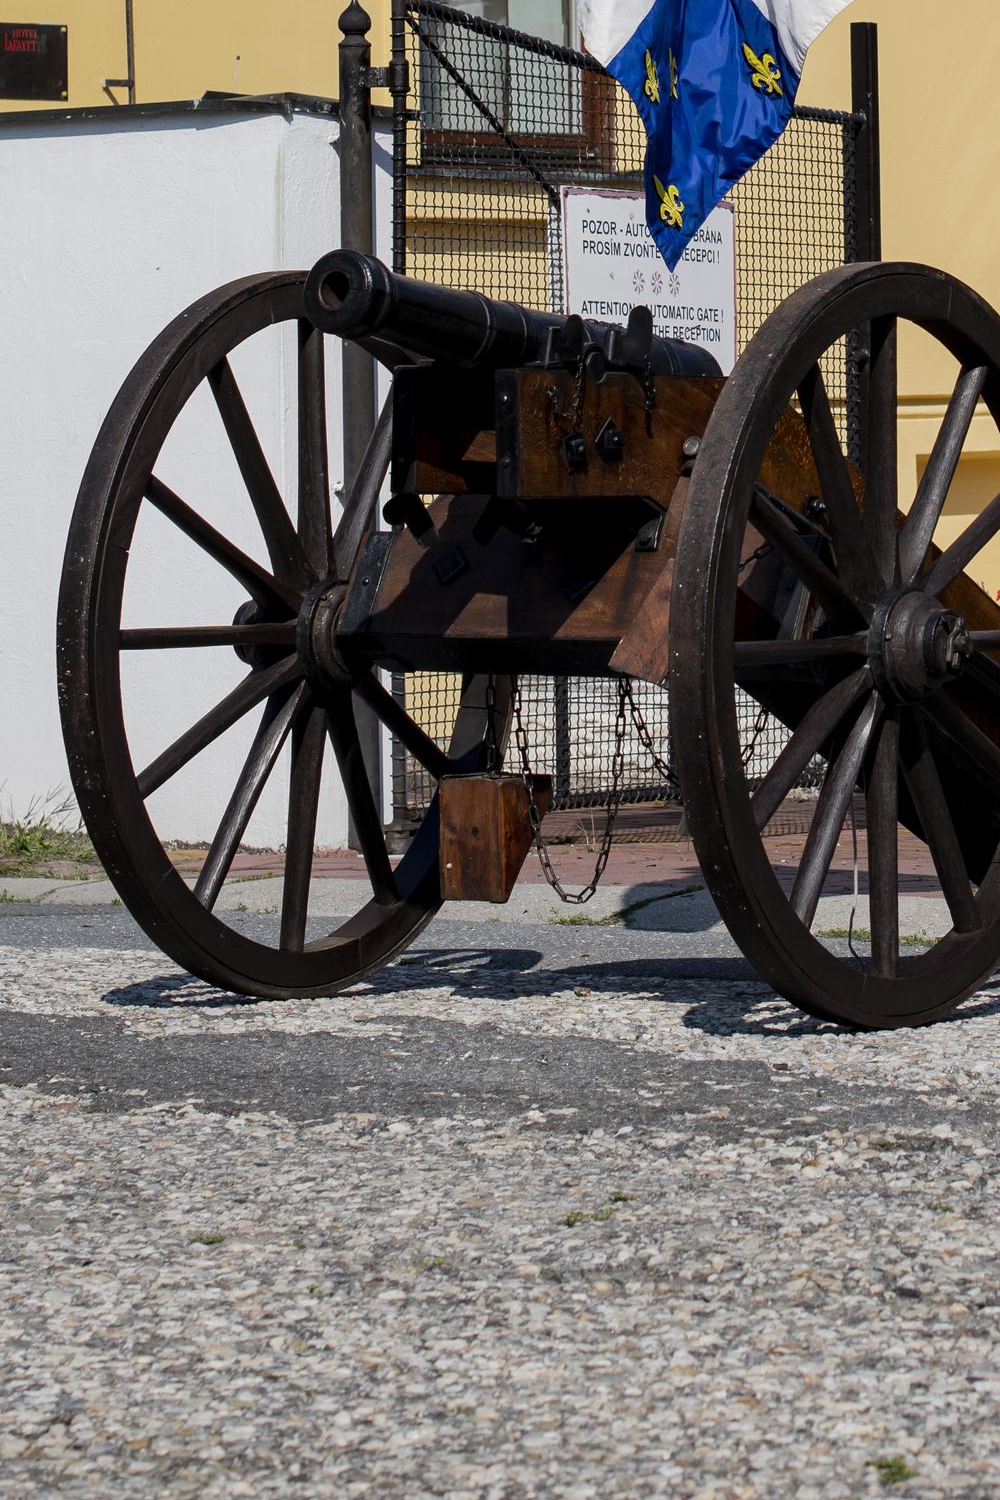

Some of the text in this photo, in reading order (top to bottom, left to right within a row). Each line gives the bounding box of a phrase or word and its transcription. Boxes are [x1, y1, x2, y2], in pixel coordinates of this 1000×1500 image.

[13, 28, 38, 38] HOTEL
[582, 219, 617, 236] POZOR
[582, 238, 621, 256] PROSÍM
[681, 247, 715, 264] ECEPCI
[645, 304, 695, 321] UTOMATIC
[696, 307, 719, 323] GATE
[653, 325, 721, 343] THE RECEPTION
